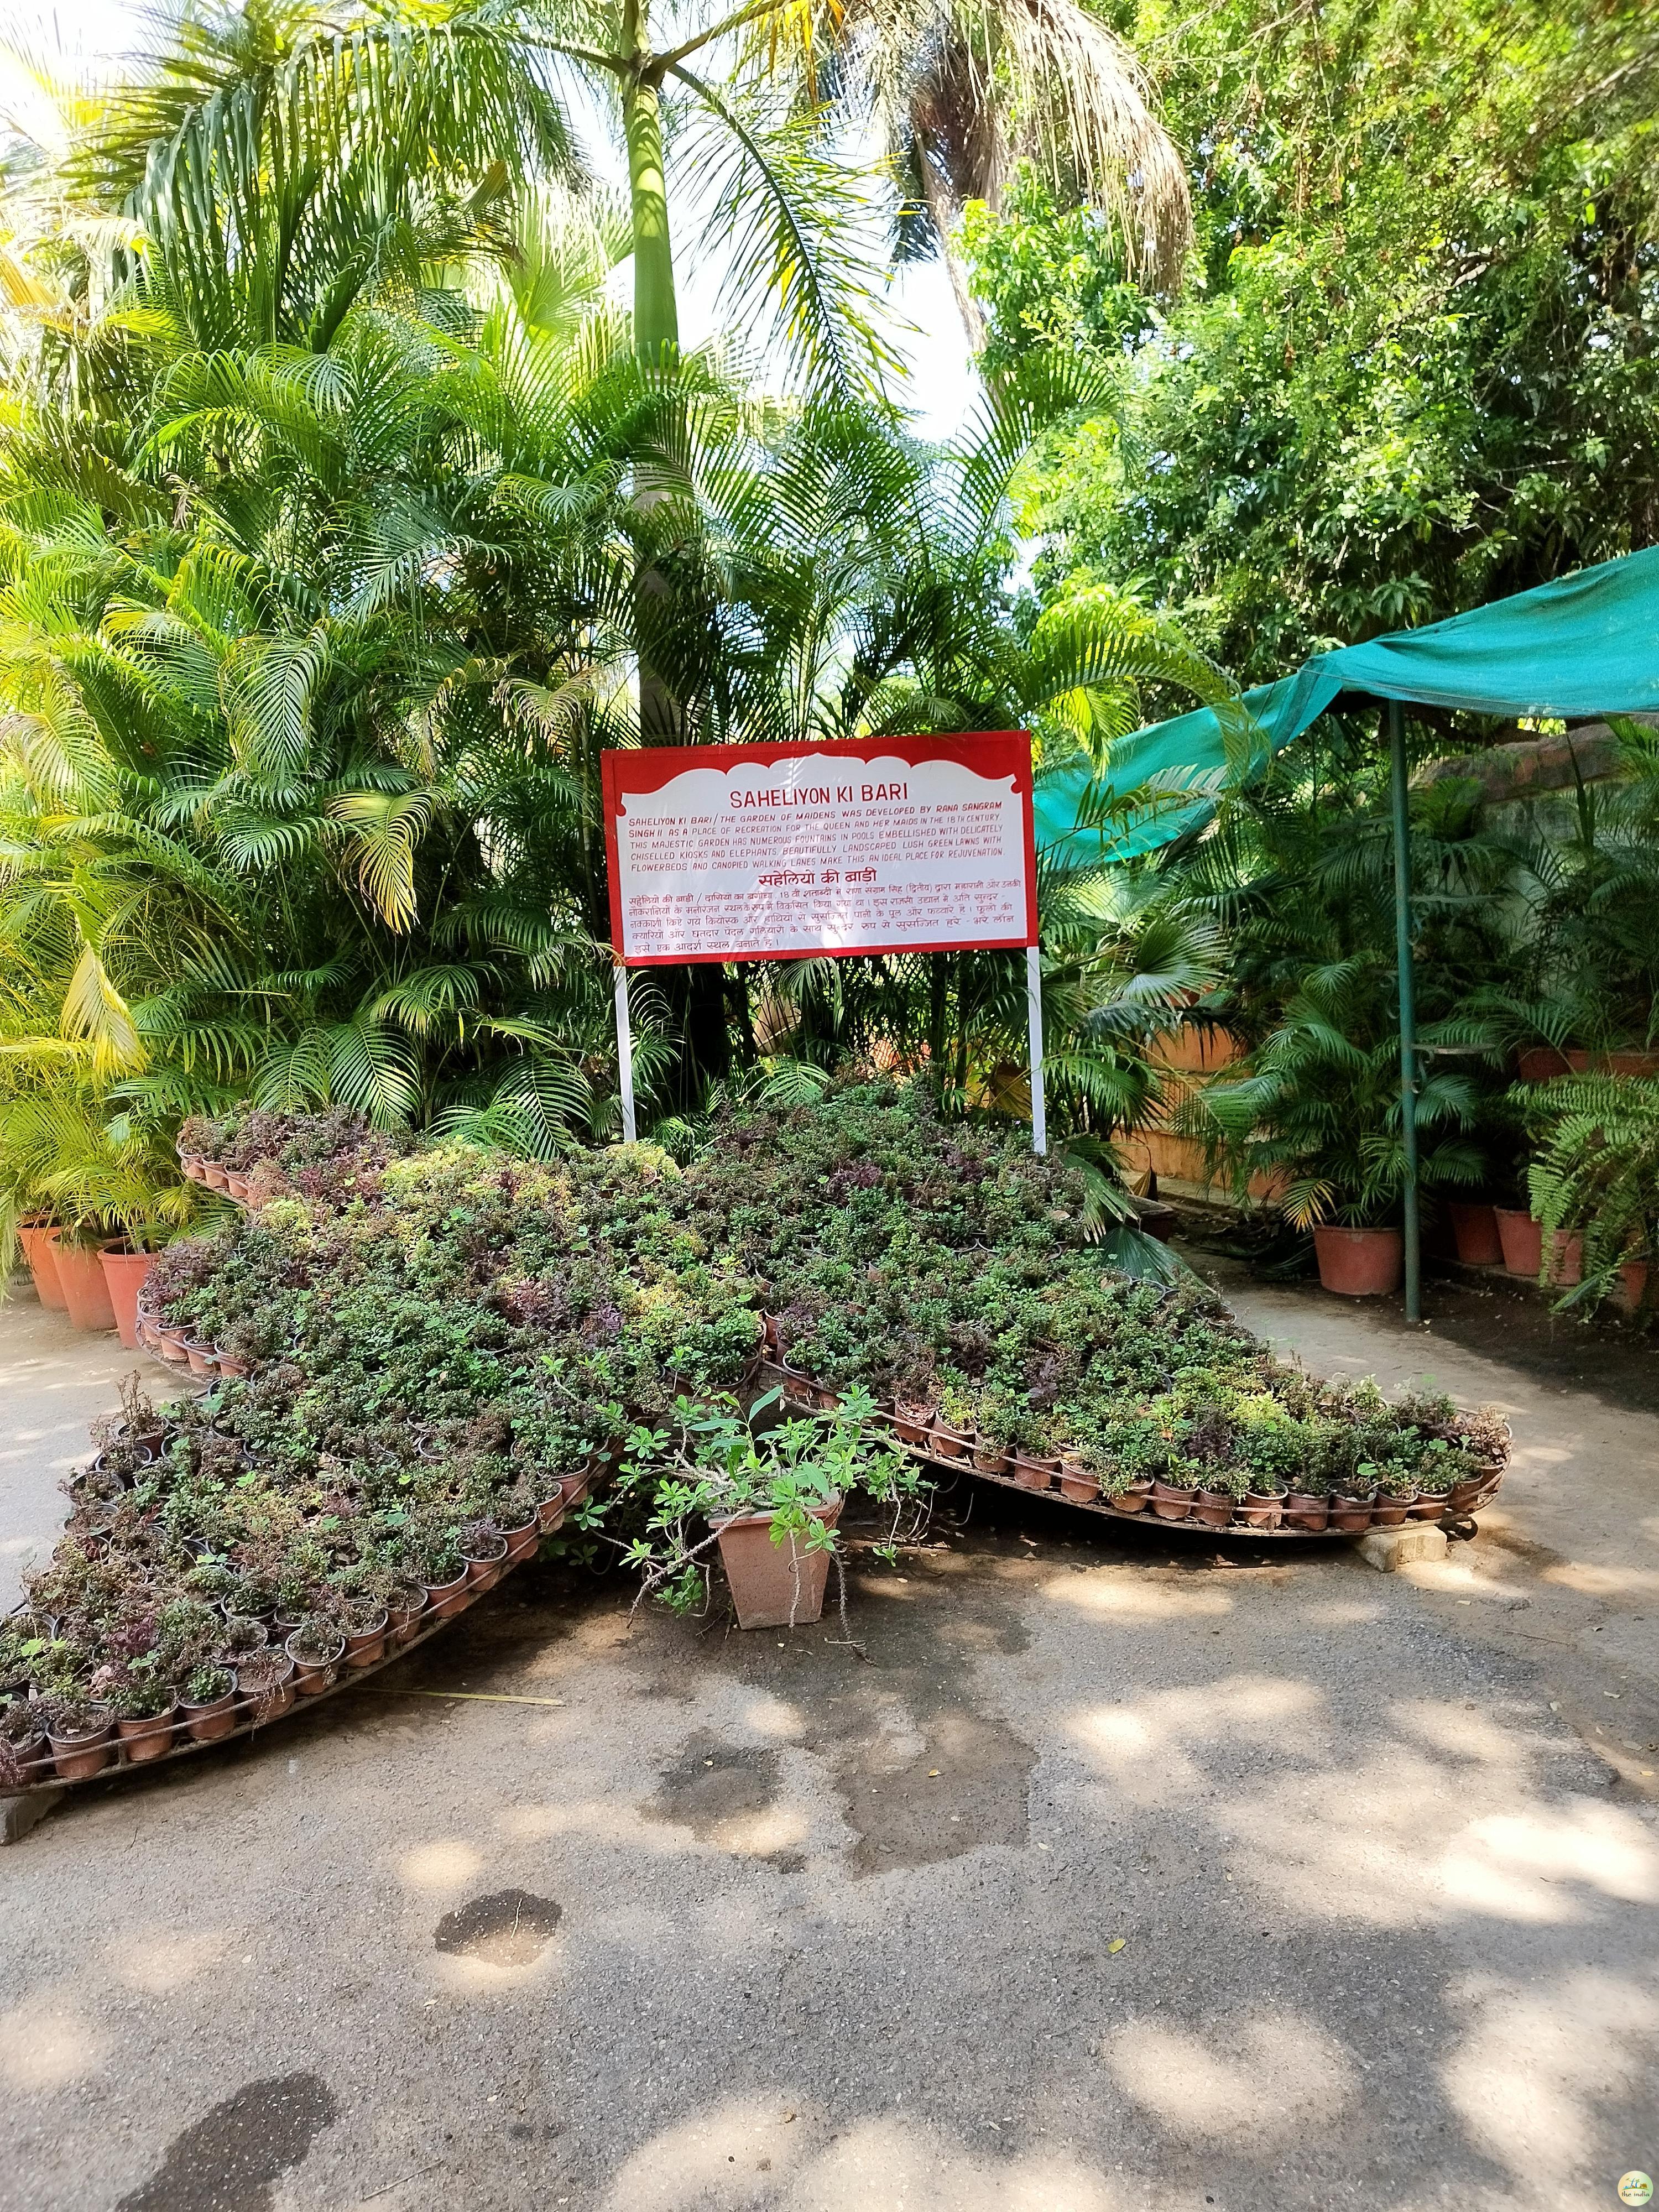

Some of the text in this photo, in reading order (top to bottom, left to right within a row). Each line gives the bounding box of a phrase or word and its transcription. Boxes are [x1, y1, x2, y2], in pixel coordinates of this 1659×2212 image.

[730, 782, 907, 808] SAHELIYON KI BARI
[629, 817, 675, 826] SAHELIYON
[740, 814, 775, 823] GARDEN
[796, 811, 836, 820] MAIDENS
[866, 807, 915, 816] DEVELOPED
[962, 802, 1002, 811] SANGRAM
[629, 830, 654, 838] SINGH
[735, 825, 781, 834] RECREATION
[652, 840, 693, 848] MAJESTIC
[698, 838, 729, 847] GARDEN
[750, 836, 791, 845] NUMEROUS
[795, 834, 836, 843] FOUNTAINS
[852, 832, 874, 840] POOLS
[879, 828, 936, 839] EMBELLISHED
[961, 825, 1003, 834] DELICATELY
[631, 852, 675, 860] CHISELLED
[680, 851, 708, 859] KIOSKS
[783, 845, 837, 855] BEAUTIFULLY
[843, 842, 896, 852] LANDSCAPED
[956, 838, 979, 846] LAWNS
[631, 863, 687, 872] FLOWERBEDS
[712, 861, 748, 869] CANOPIED
[752, 859, 786, 868] WALKING
[791, 858, 816, 867] LANES
[820, 856, 843, 864] MAKE
[848, 855, 864, 864] THIS
[882, 853, 902, 862] IDEAL
[906, 852, 928, 860] PLACE
[821, 869, 839, 883] की
[662, 894, 672, 902] की
[776, 901, 808, 911] विकसित
[873, 898, 887, 908] इस
[798, 912, 806, 921] से
[854, 909, 871, 918] पानी
[790, 924, 798, 932] के
[881, 920, 890, 928] से
[634, 942, 650, 954] इसे
[657, 943, 670, 952] एक
